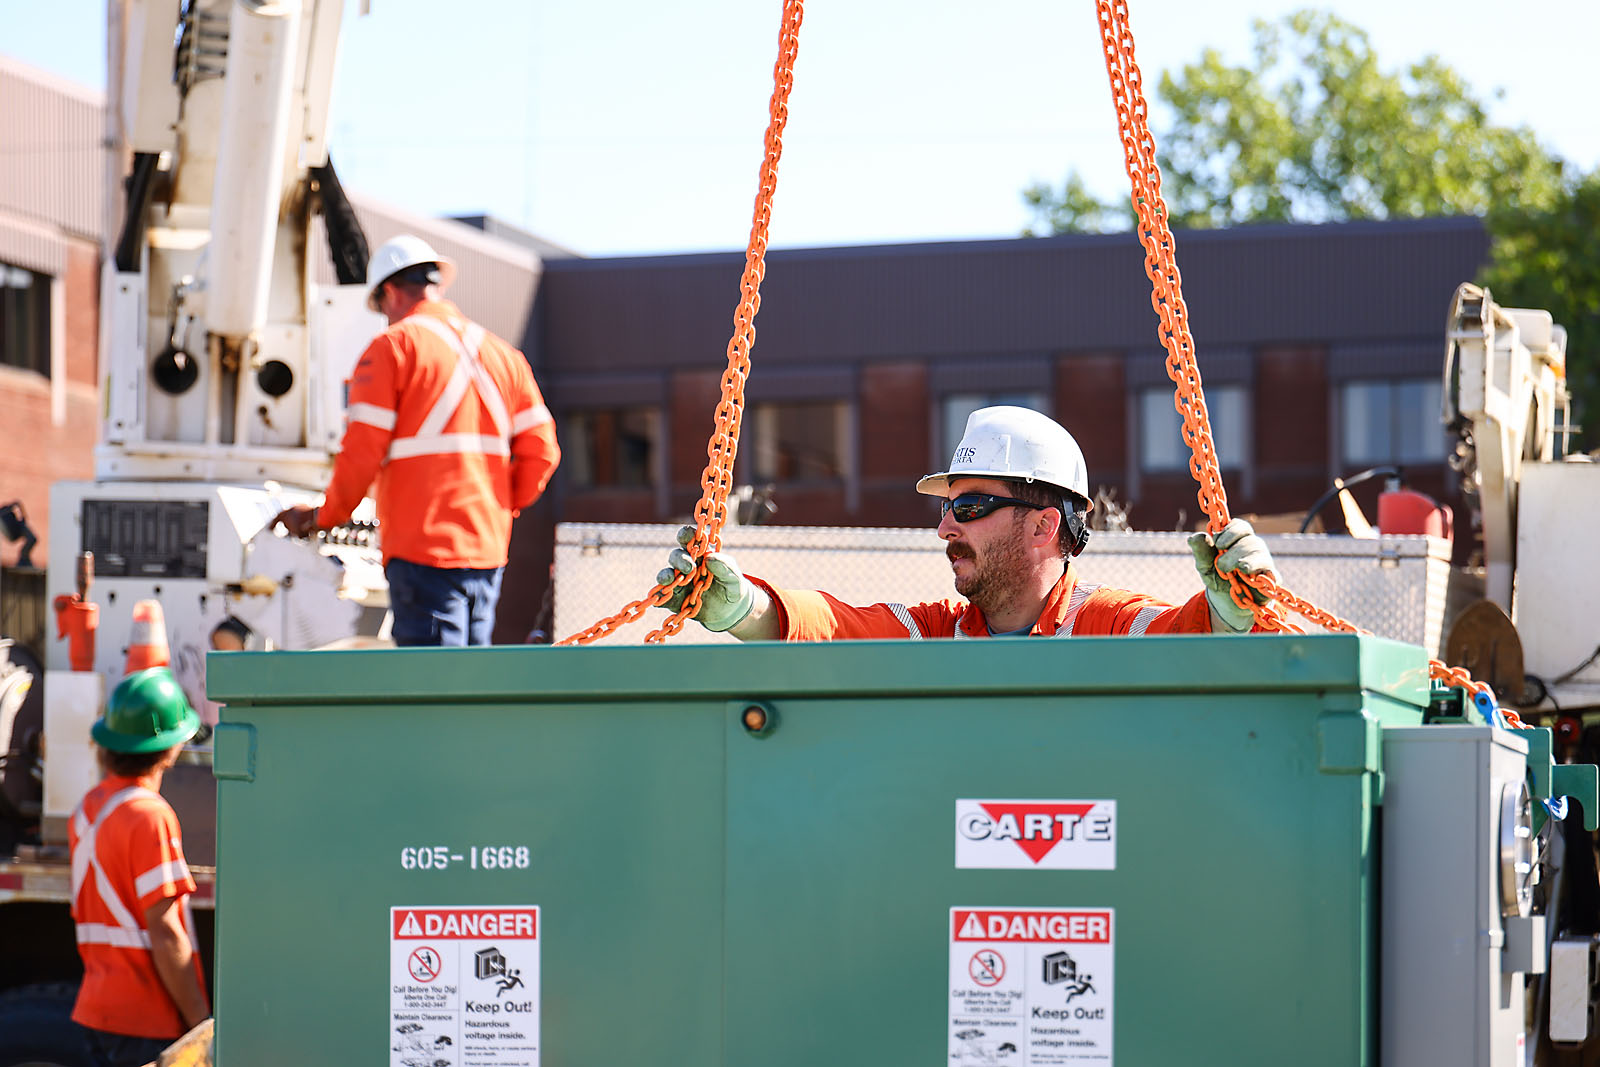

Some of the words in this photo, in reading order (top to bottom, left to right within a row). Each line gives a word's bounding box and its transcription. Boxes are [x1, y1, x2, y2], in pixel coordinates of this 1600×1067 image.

[959, 812, 1112, 842] CARTE
[400, 846, 530, 870] 605-1668
[424, 913, 534, 937] DANGER
[987, 915, 1108, 941] DANGER
[393, 985, 406, 994] Call
[407, 985, 429, 994] Before
[430, 985, 443, 994] You
[465, 1000, 501, 1015] Keep
[504, 1000, 533, 1013] Out!
[1031, 1006, 1070, 1021] Keep
[1074, 1007, 1105, 1020] Out!
[393, 1013, 420, 1021] Maintain
[421, 1013, 453, 1021] Clearance
[464, 1020, 511, 1029] Hazardous
[464, 1031, 496, 1041] voltage
[498, 1031, 527, 1040] inside.
